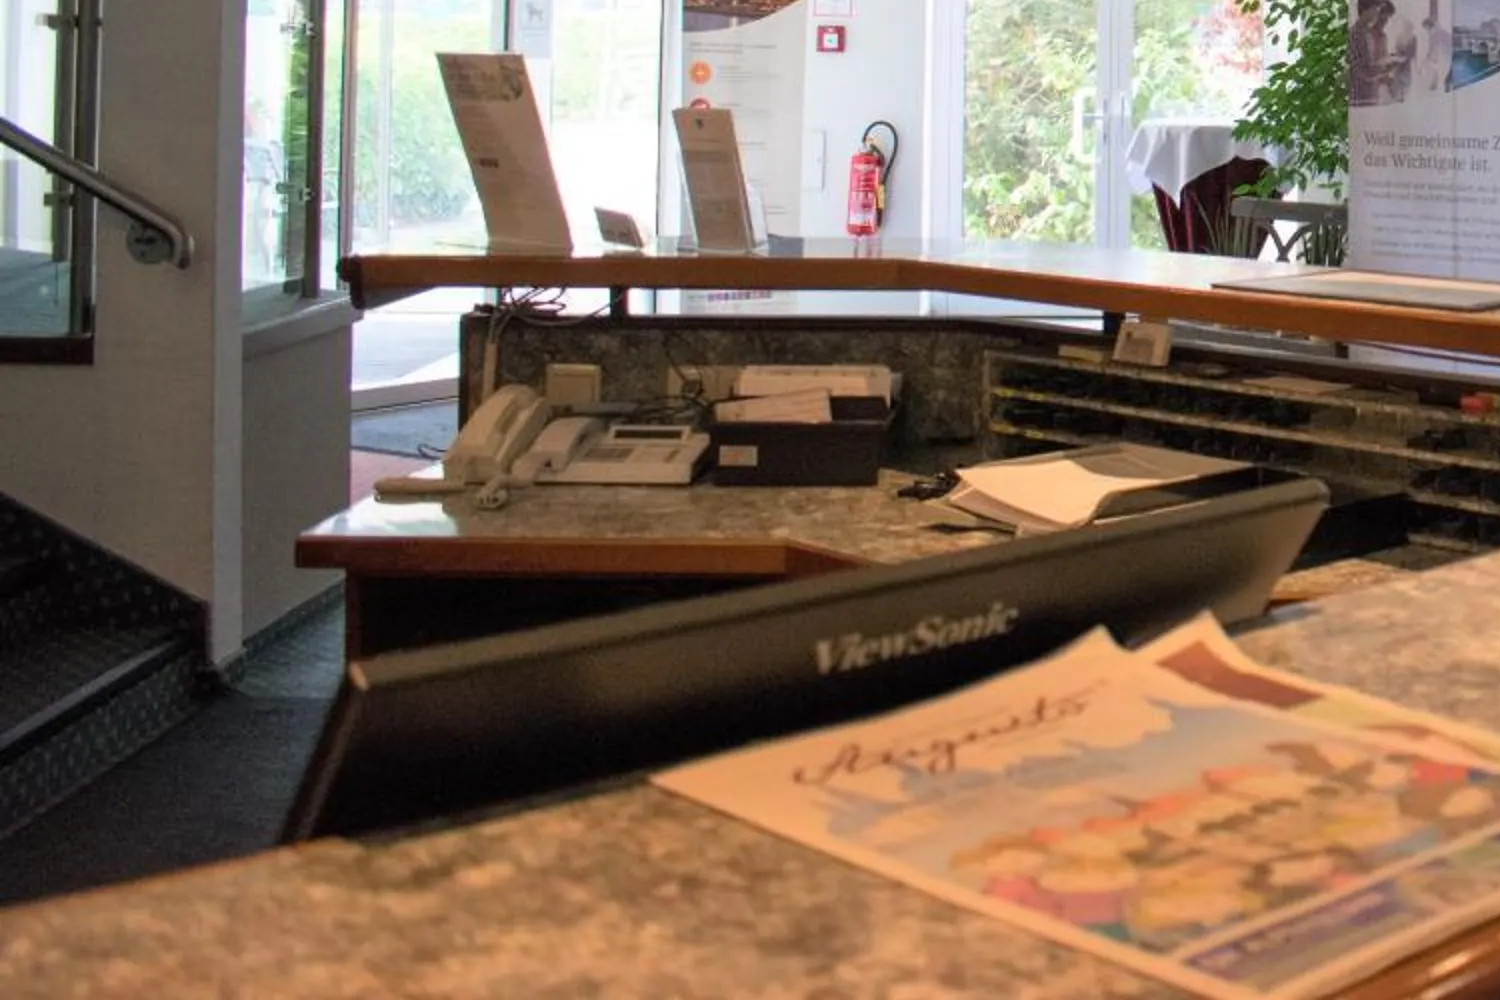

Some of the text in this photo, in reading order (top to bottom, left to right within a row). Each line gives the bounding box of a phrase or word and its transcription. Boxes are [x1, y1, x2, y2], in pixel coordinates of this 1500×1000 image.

[1364, 130, 1395, 147] Weil
[1399, 132, 1489, 152] gemeinsame
[1363, 151, 1492, 173] das Wichtigste ist.
[813, 602, 1019, 675] ViewSonic
